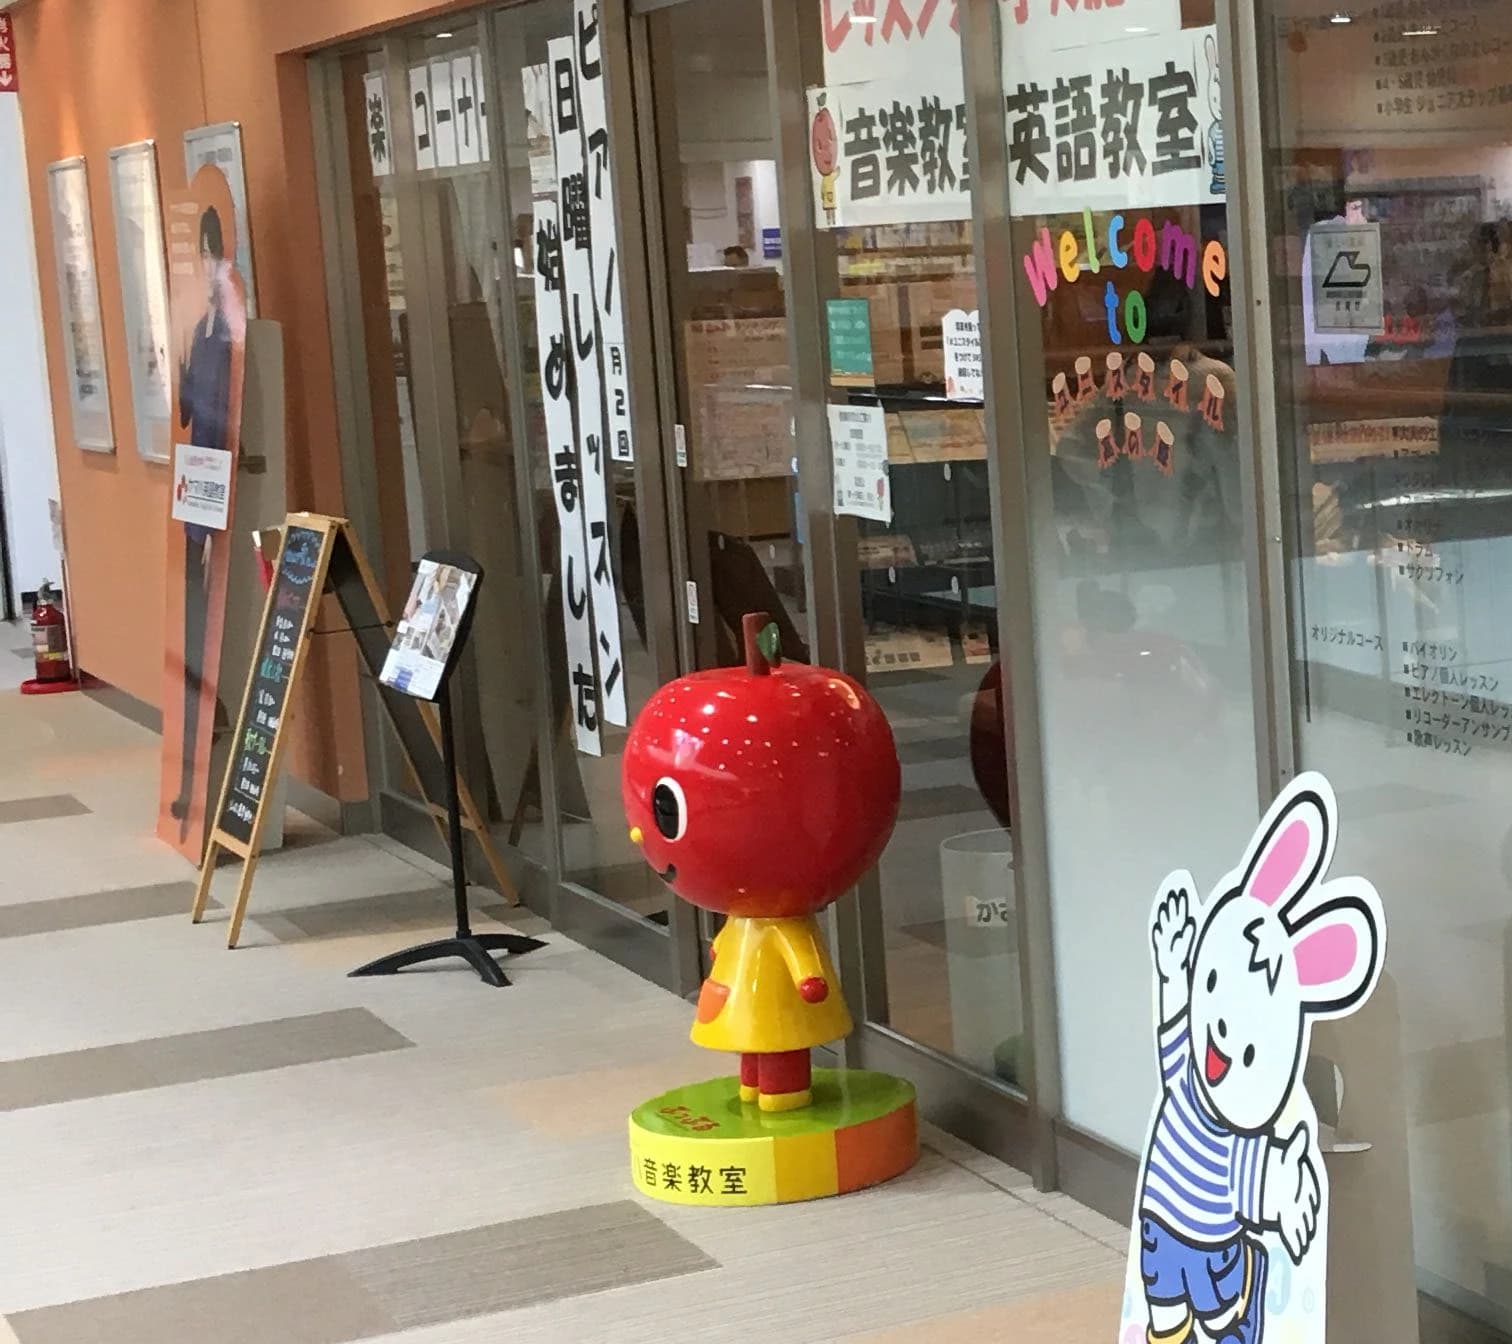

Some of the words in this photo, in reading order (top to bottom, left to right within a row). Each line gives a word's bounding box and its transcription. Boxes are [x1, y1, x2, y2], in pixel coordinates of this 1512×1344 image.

[1006, 61, 1202, 184] 英語教室
[1024, 206, 1226, 305] Welcome
[1104, 280, 1147, 345] to
[1311, 624, 1385, 653] オリジナルコース
[643, 1158, 748, 1196] 音楽教室
